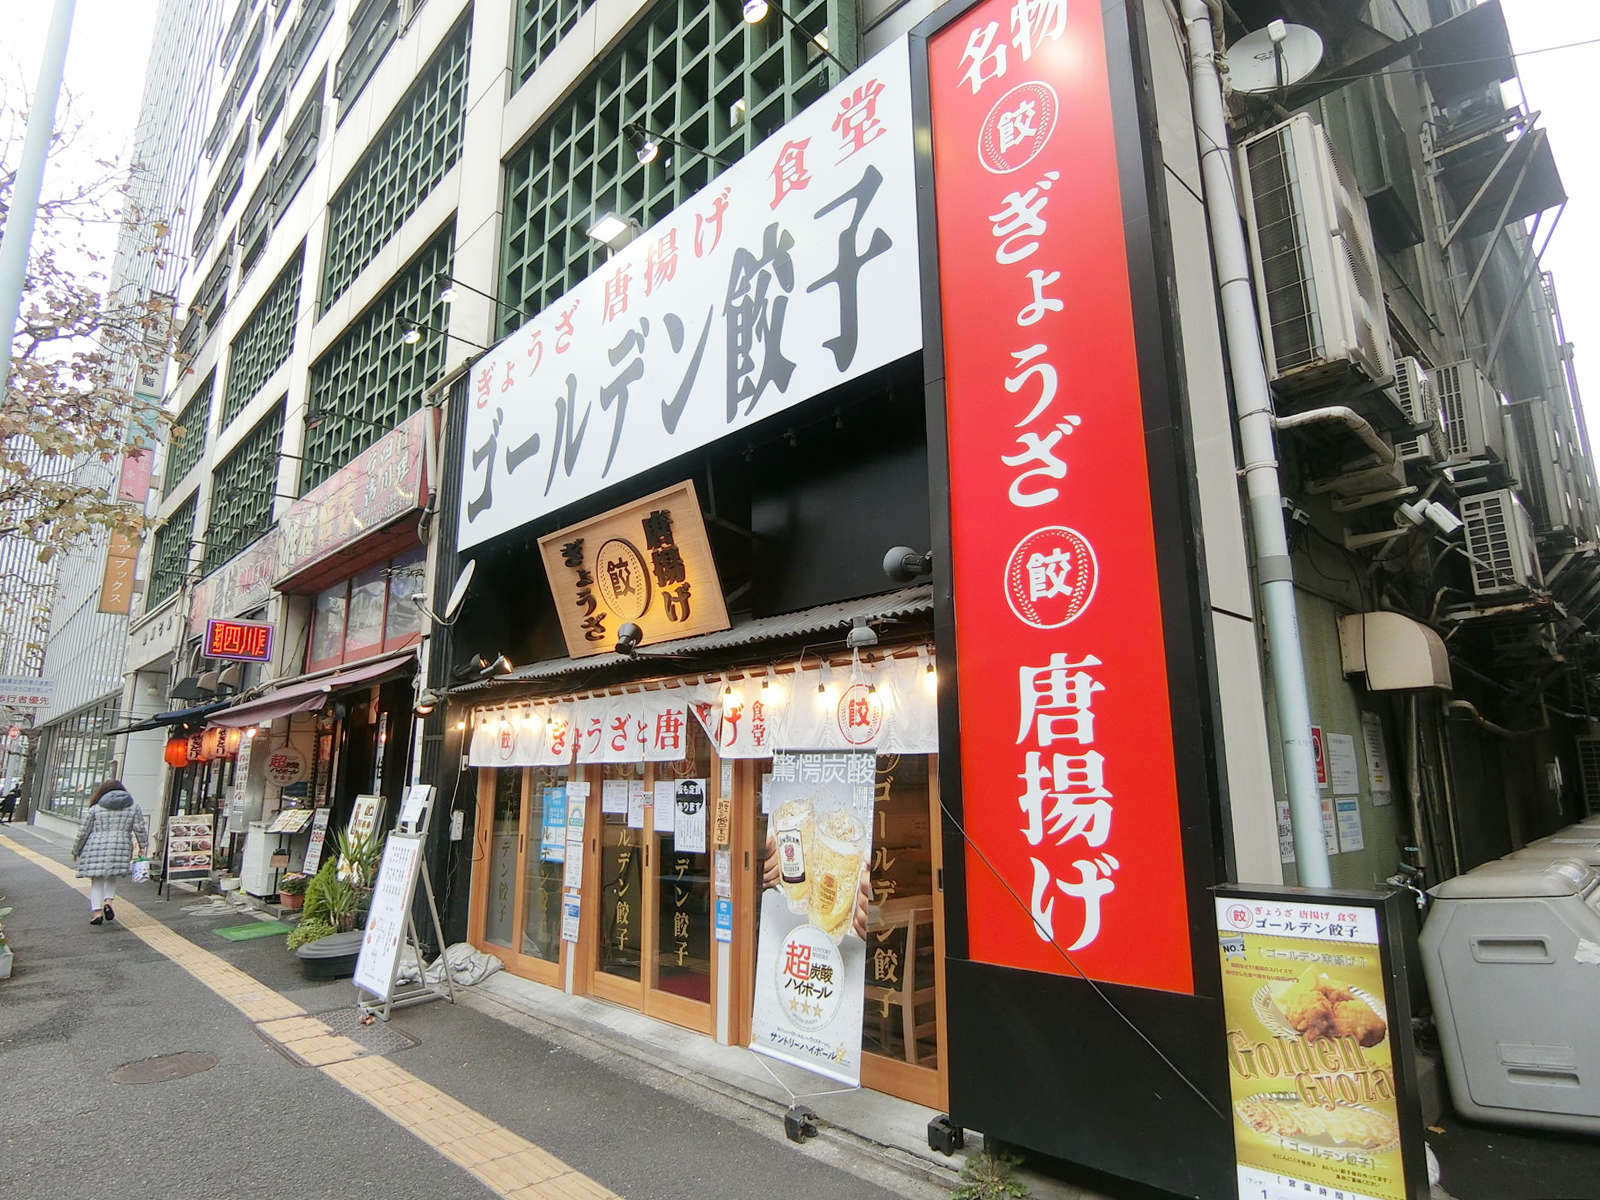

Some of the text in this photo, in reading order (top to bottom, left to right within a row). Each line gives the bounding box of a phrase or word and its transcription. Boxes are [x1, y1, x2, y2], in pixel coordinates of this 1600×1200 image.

[476, 78, 888, 410] ぎょうざ 唐揚げ 食堂
[468, 164, 893, 525] ゴールデン餃子
[957, 0, 1120, 951] 名物 餃 ぎょうざ 餃 唐揚げ
[606, 556, 636, 600] 餃
[641, 508, 692, 623] 唐揚げ
[559, 537, 608, 642] ぎょうざ
[750, 700, 766, 747] 食堂
[848, 698, 871, 728] 餃
[771, 753, 876, 784] 驚愕炭酸
[872, 775, 900, 1019] ゴールデン餃子
[1232, 909, 1247, 923] 餃
[1255, 906, 1358, 923] ぎょうざ 唐揚げ 食堂
[1222, 943, 1246, 953] NO.2
[1255, 918, 1360, 938] ゴールデン餃子
[783, 940, 812, 981] 超
[808, 962, 834, 986] 炭酸
[784, 977, 833, 1000] ハイボール
[770, 1031, 837, 1061] サントリーハイボール
[1227, 1030, 1370, 1080] Golden
[1294, 1068, 1395, 1112] Gyoza
